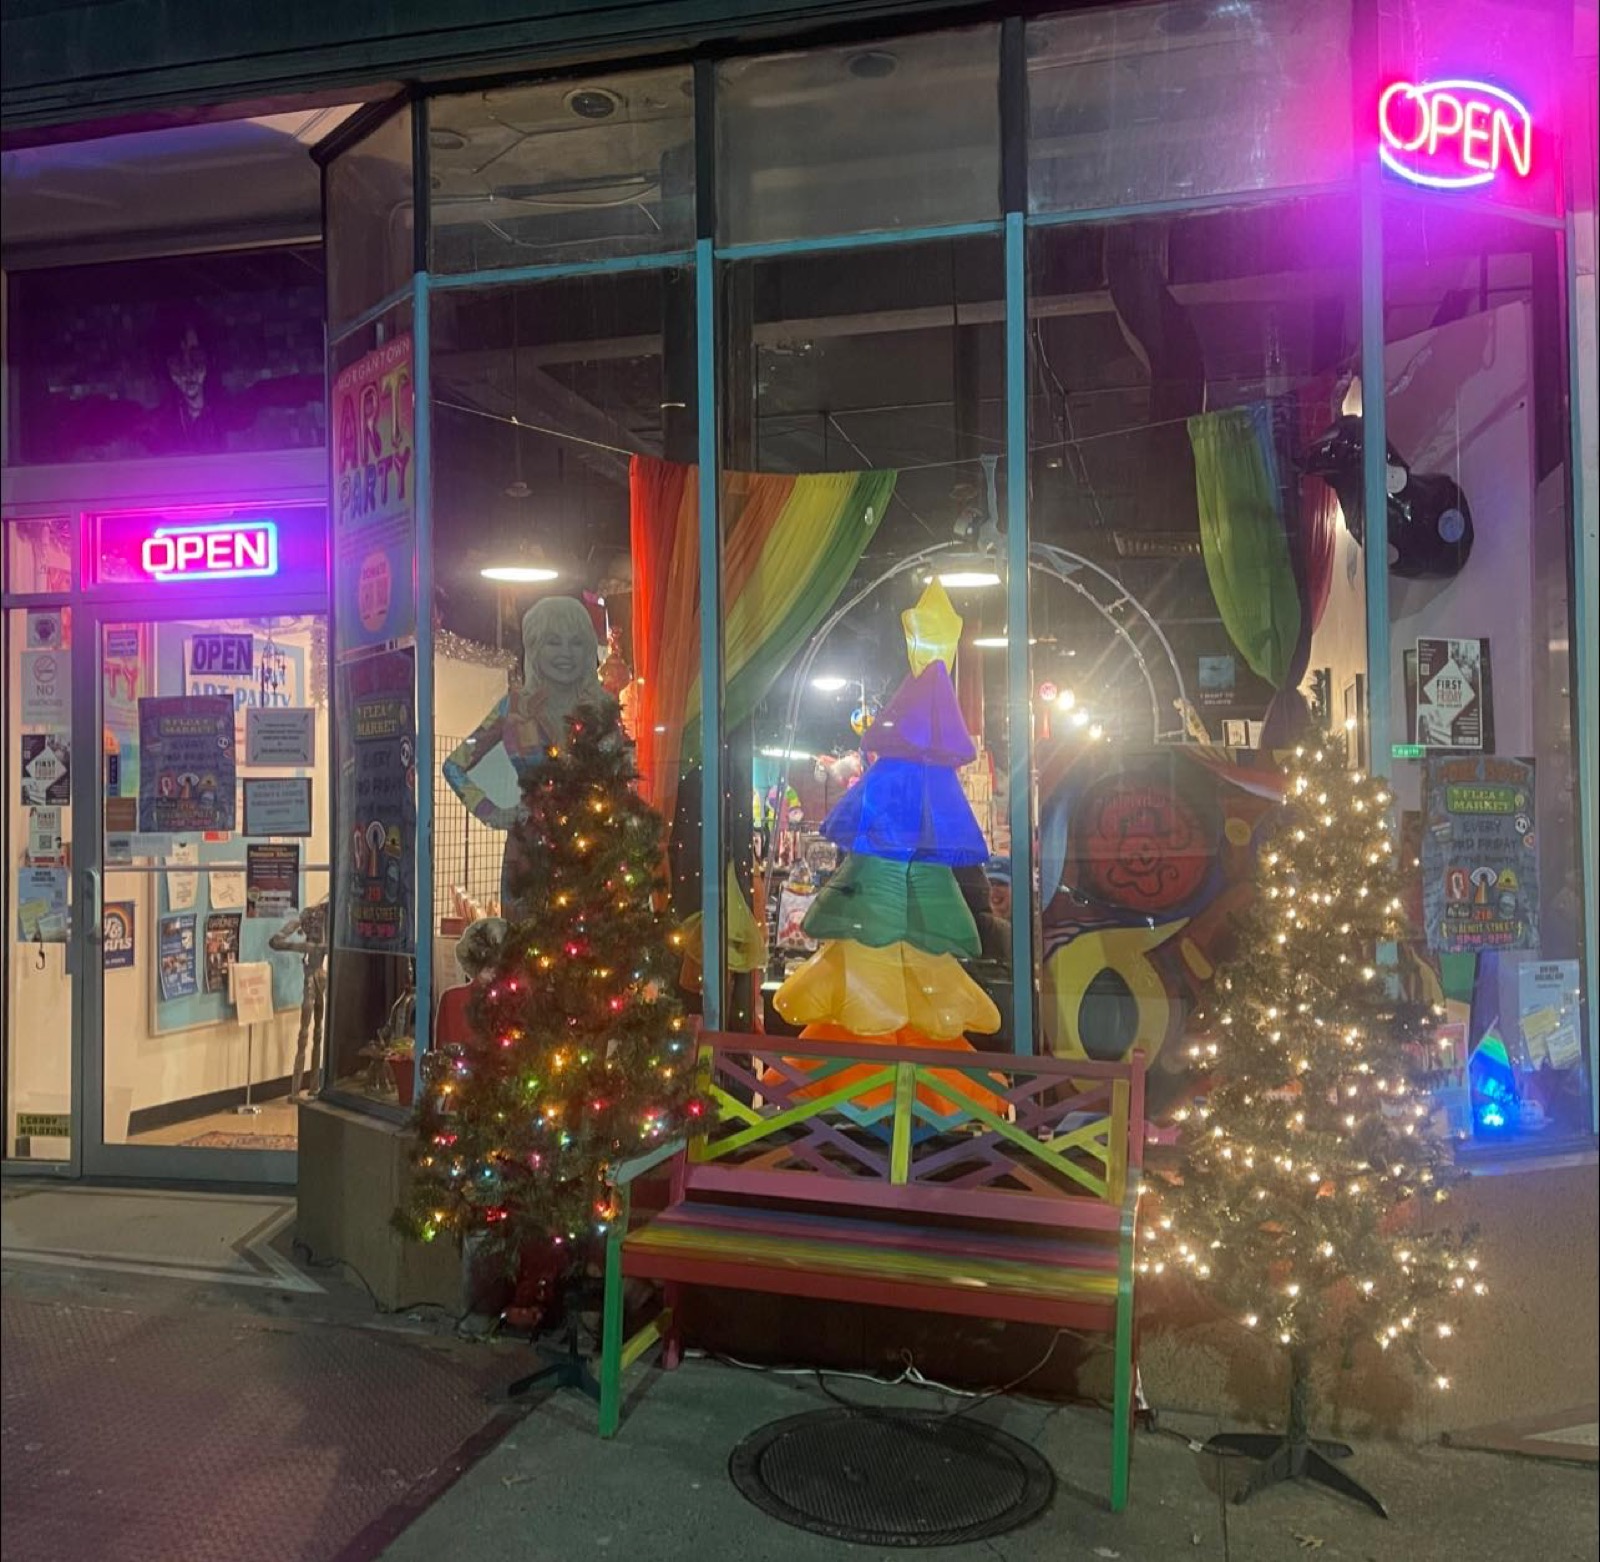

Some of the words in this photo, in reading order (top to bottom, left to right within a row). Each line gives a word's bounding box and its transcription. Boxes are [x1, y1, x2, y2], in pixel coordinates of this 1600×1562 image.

[1379, 82, 1531, 177] OPEN
[337, 338, 411, 388] MORGANTOWN
[339, 362, 409, 475] ART
[338, 446, 411, 526] PARTY
[142, 530, 267, 573] OPEN
[193, 640, 252, 671] OPEN
[36, 685, 54, 697] NO
[1437, 680, 1462, 690] FIRST
[357, 719, 396, 736] MARKET
[1453, 801, 1508, 811] MARKET
[1463, 789, 1496, 800] FLEA
